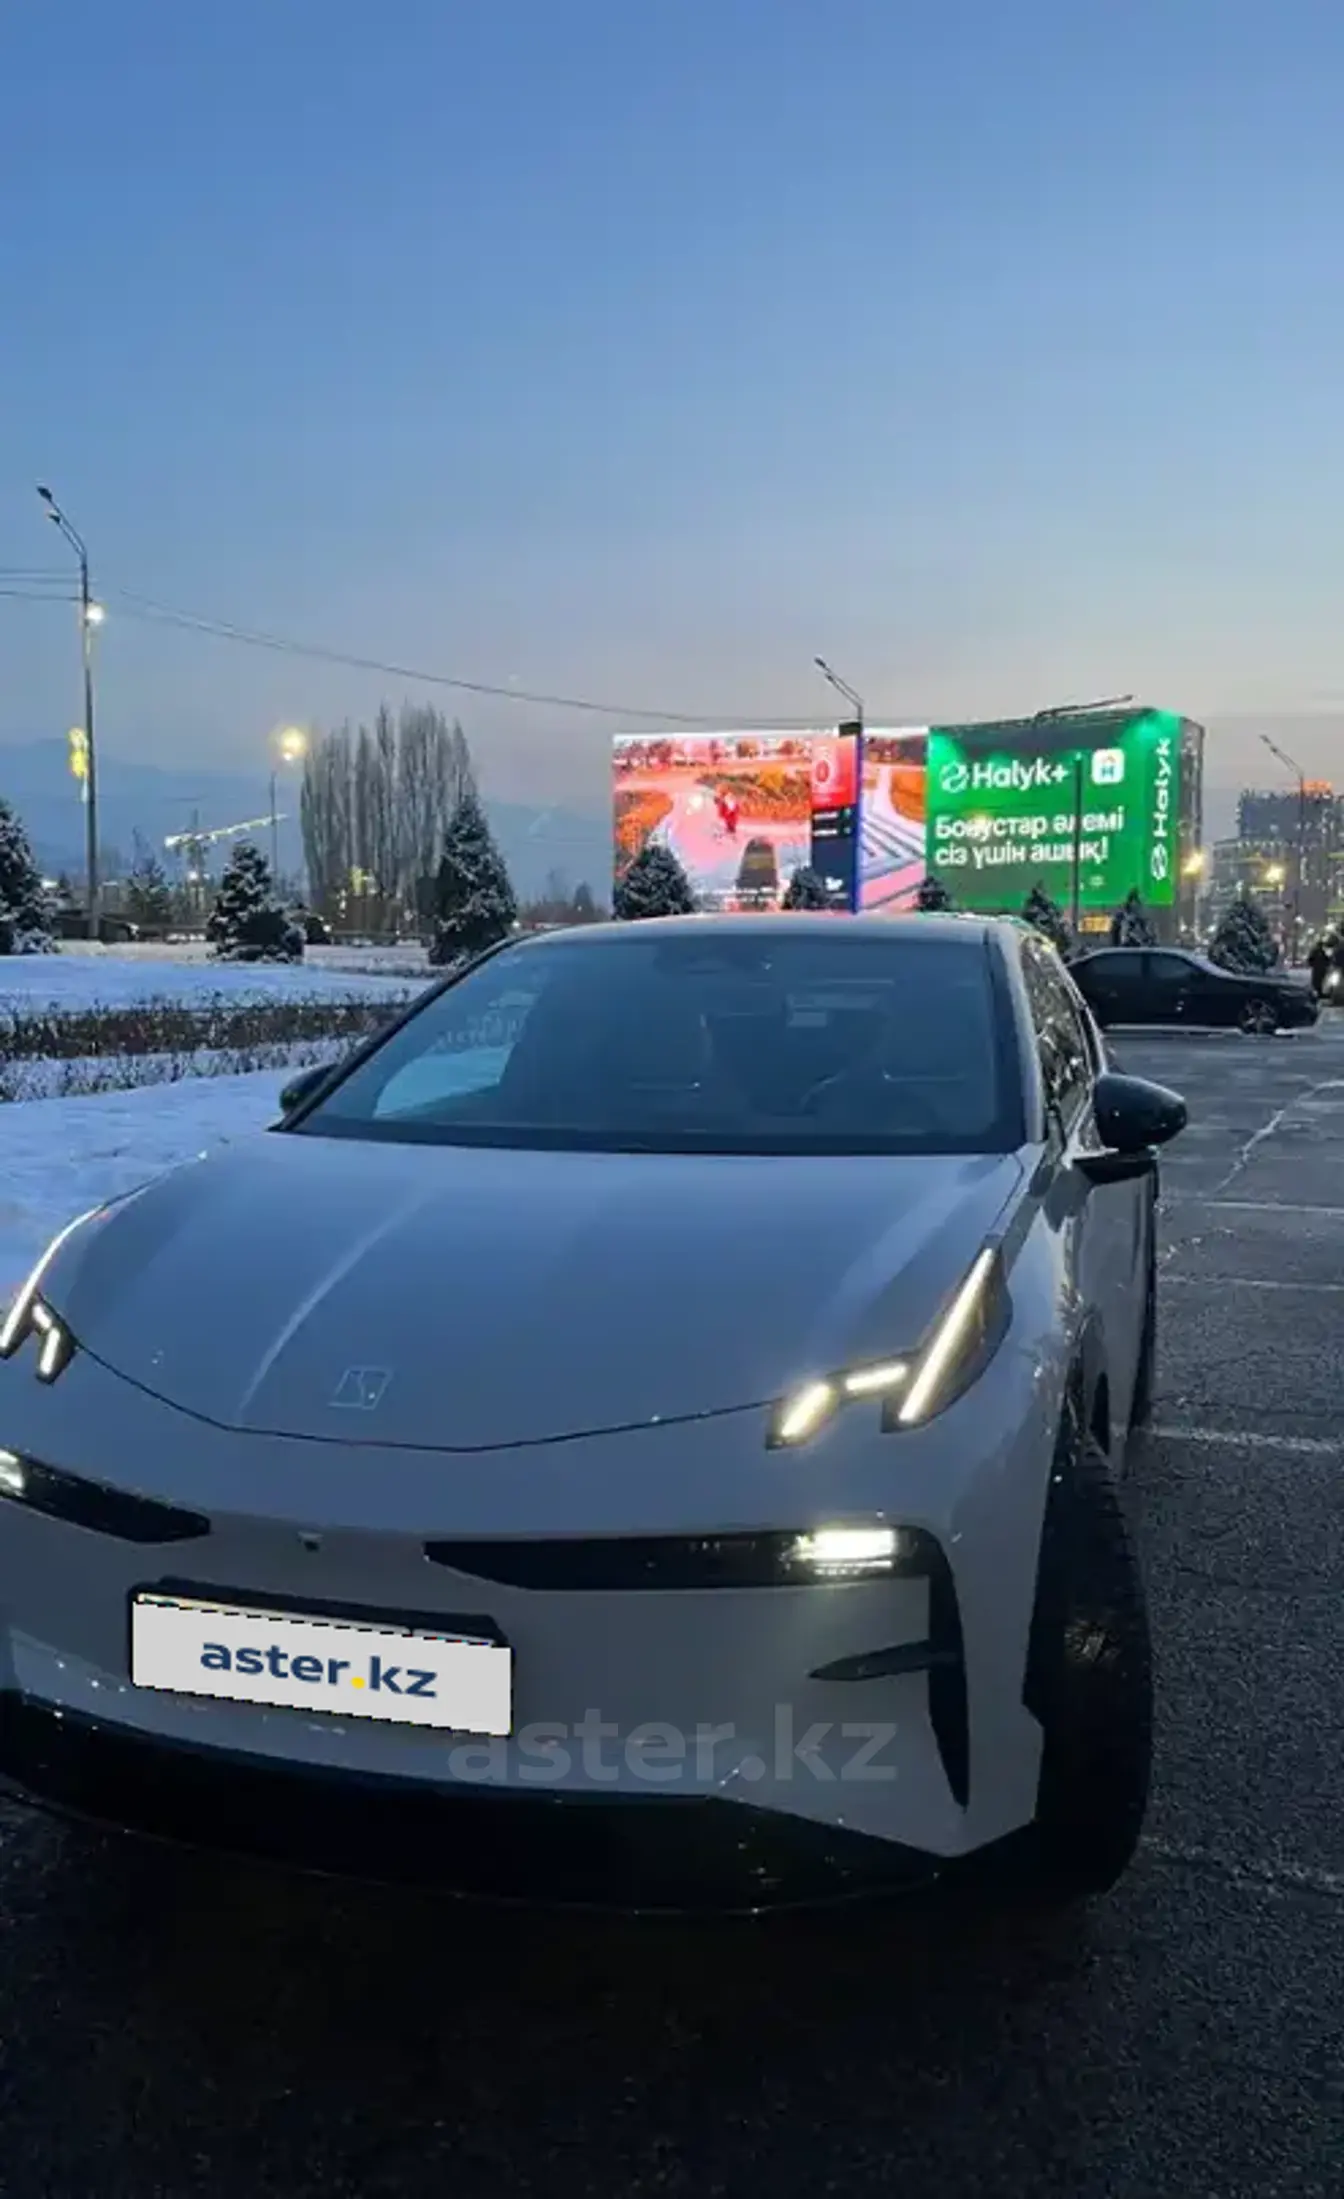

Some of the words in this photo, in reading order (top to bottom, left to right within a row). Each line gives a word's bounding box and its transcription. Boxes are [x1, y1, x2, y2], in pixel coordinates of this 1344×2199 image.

[972, 757, 1068, 791] Halyk+
[1153, 737, 1172, 838] Halyk
[935, 844, 966, 866] сіз
[972, 841, 1026, 869] үшін
